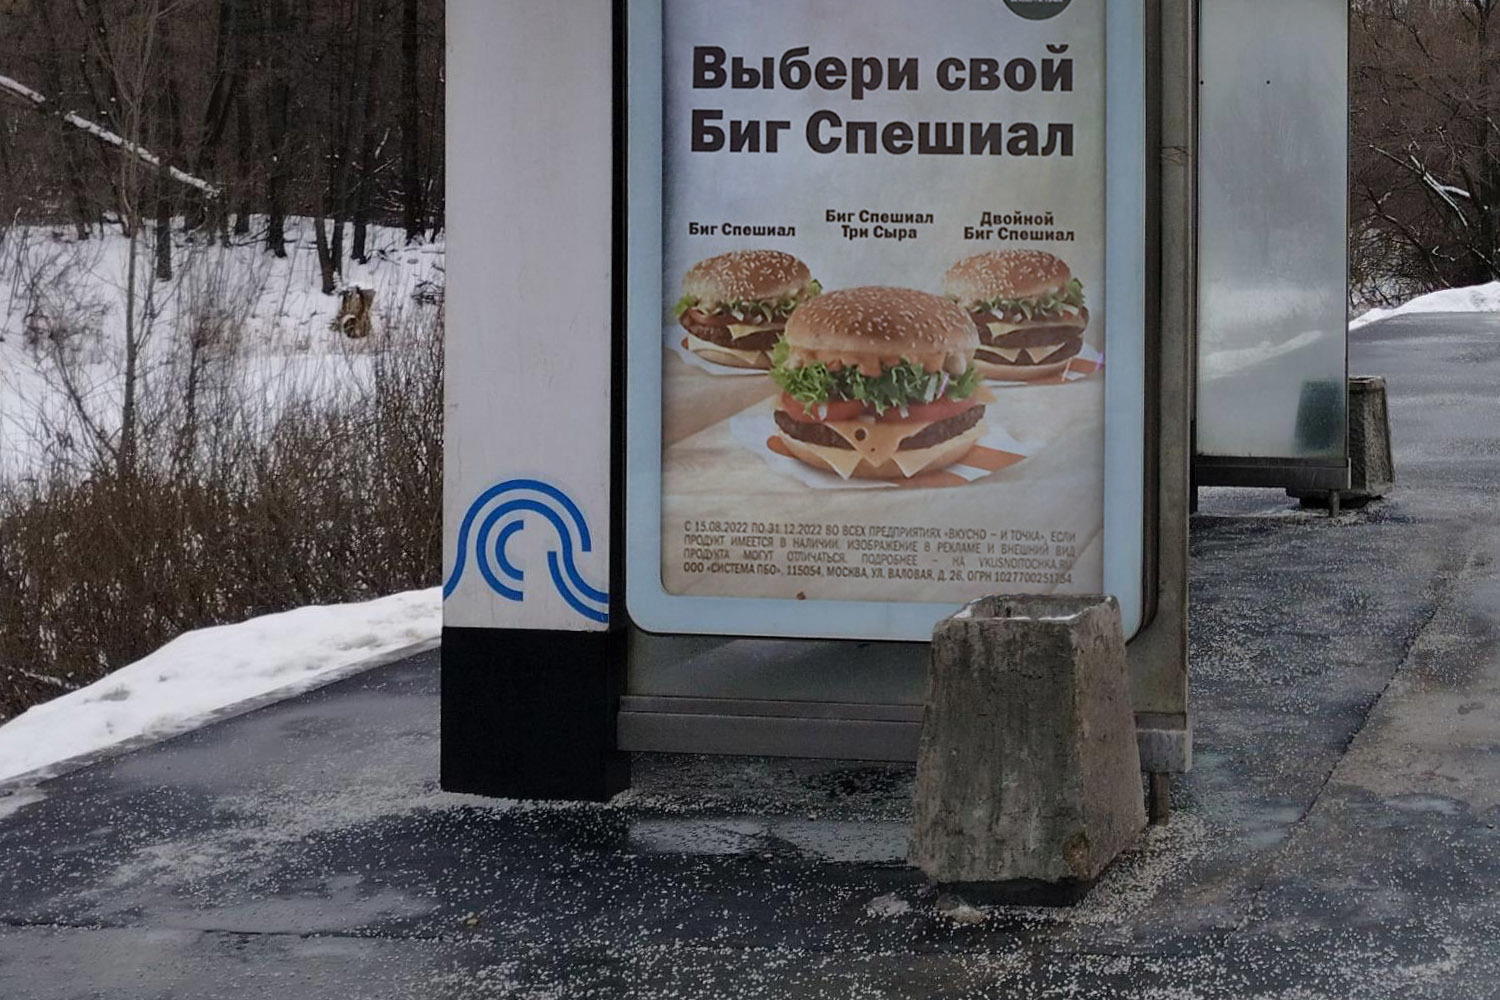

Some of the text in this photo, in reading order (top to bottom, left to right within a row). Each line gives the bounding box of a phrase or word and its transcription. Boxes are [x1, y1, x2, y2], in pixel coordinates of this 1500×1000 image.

[691, 44, 1074, 100] Выбери свой
[690, 109, 1074, 157] Биг Спешиал
[825, 209, 934, 225] Биг Спешиал
[980, 210, 1055, 228] Двойной
[688, 222, 796, 238] Биг Спешиал
[841, 226, 918, 242] Три Сыра
[963, 227, 1075, 243] Биг Спешиал
[695, 521, 748, 533] 15.08.2022
[751, 522, 765, 534] ПО
[768, 523, 822, 536] 31.12.2022
[825, 524, 840, 536] ВО
[842, 525, 866, 537] ВСЕХ
[869, 526, 941, 539] ПРЕДПРИЯТИЯХ
[1050, 531, 1077, 543] ЕСЛИ
[684, 534, 725, 546] ПРОДУКТ
[731, 536, 774, 548] ИМЕЕТСЯ
[847, 539, 918, 552] ИЗОБРАЖЕНИЕ
[937, 541, 981, 554] РЕКЛАМЕ
[1001, 542, 1049, 556] ВНЕШНИЙ
[1055, 545, 1075, 557] ВИД
[684, 548, 730, 560] ПРОДУКТА
[743, 550, 774, 561] МОГУТ
[862, 553, 918, 566] ПОДРОБНЕЕ
[952, 556, 966, 567] НА
[967, 570, 992, 582] ОГРН
